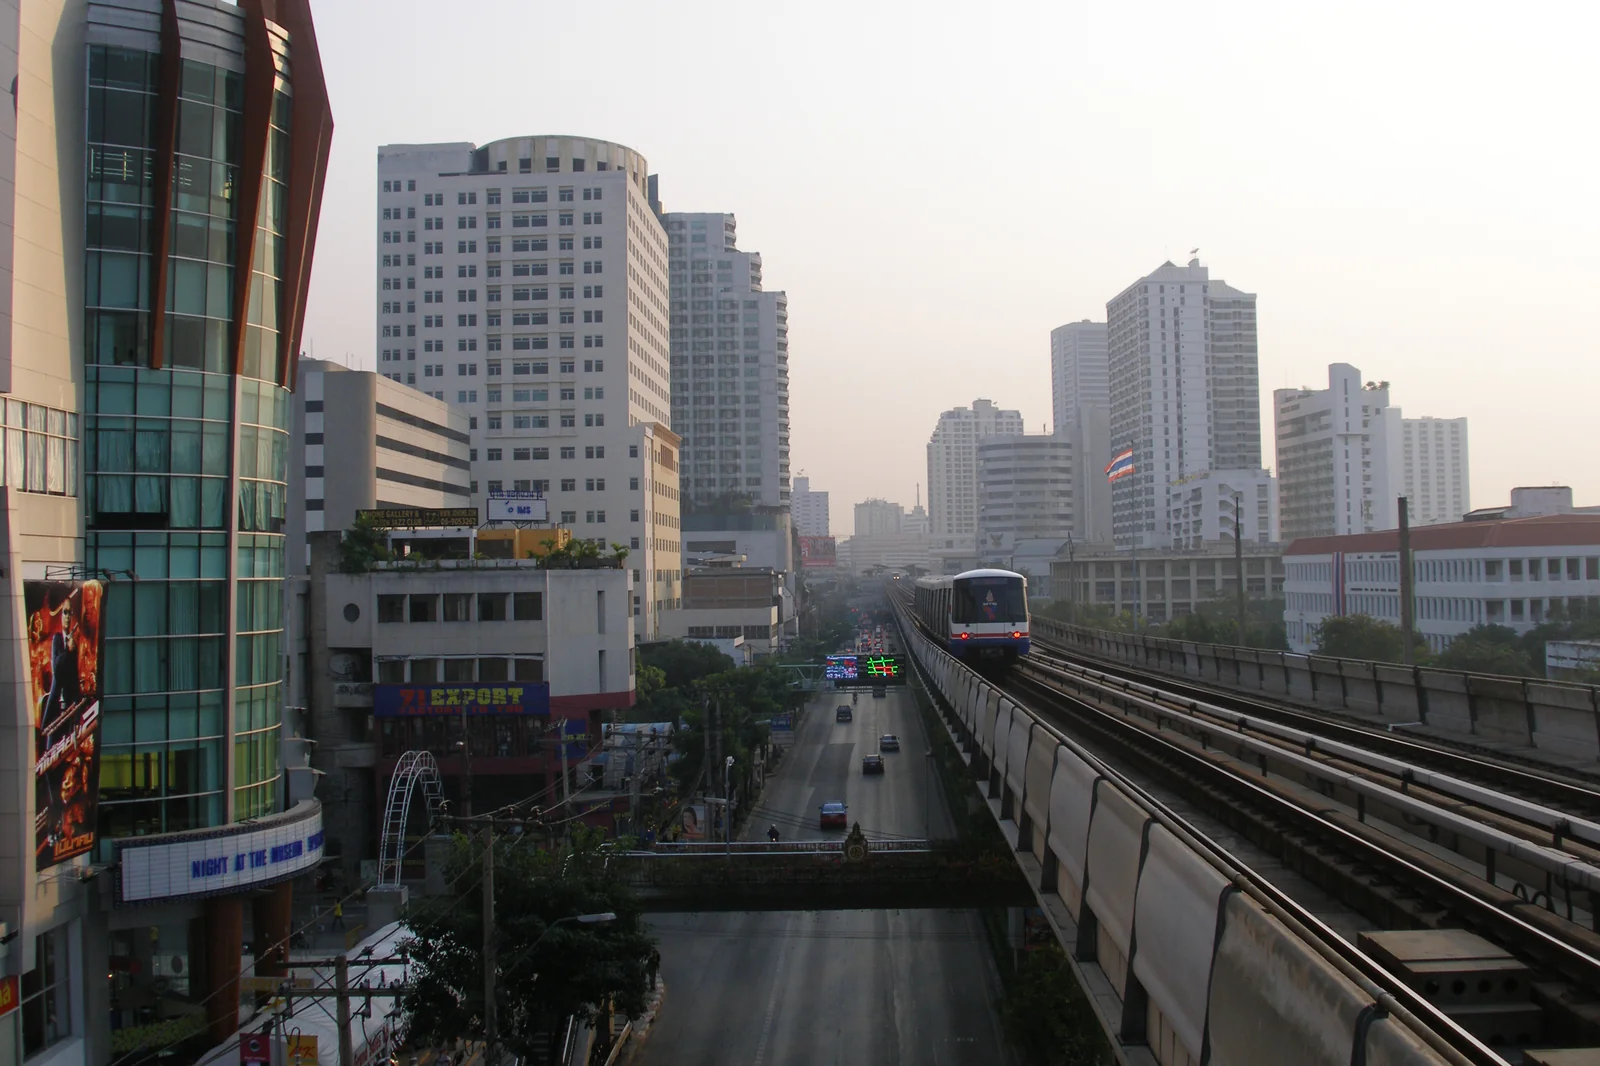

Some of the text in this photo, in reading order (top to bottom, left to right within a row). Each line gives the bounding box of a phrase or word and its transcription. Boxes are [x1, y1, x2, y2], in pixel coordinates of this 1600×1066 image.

[406, 518, 423, 526] CLUB
[430, 687, 524, 706] EXPORT
[191, 856, 229, 878] NIGHT
[234, 853, 247, 872] AT
[249, 849, 268, 868] THE
